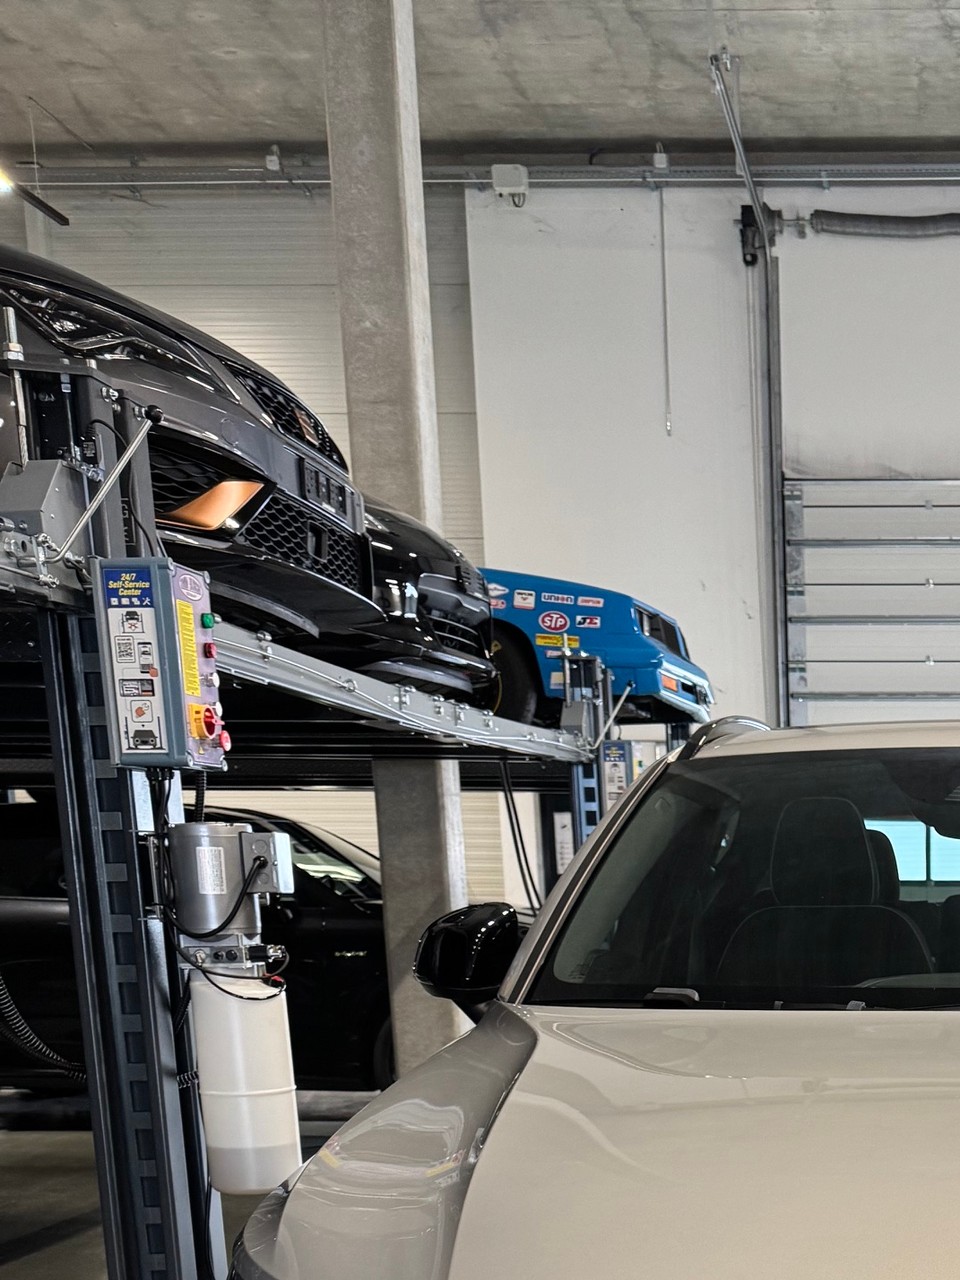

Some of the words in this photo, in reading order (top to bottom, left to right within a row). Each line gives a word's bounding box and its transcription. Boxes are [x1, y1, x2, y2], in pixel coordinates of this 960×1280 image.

[121, 573, 137, 581] 24/7
[108, 580, 150, 589] Self-Service
[118, 588, 142, 596] Center
[543, 613, 565, 628] STP
